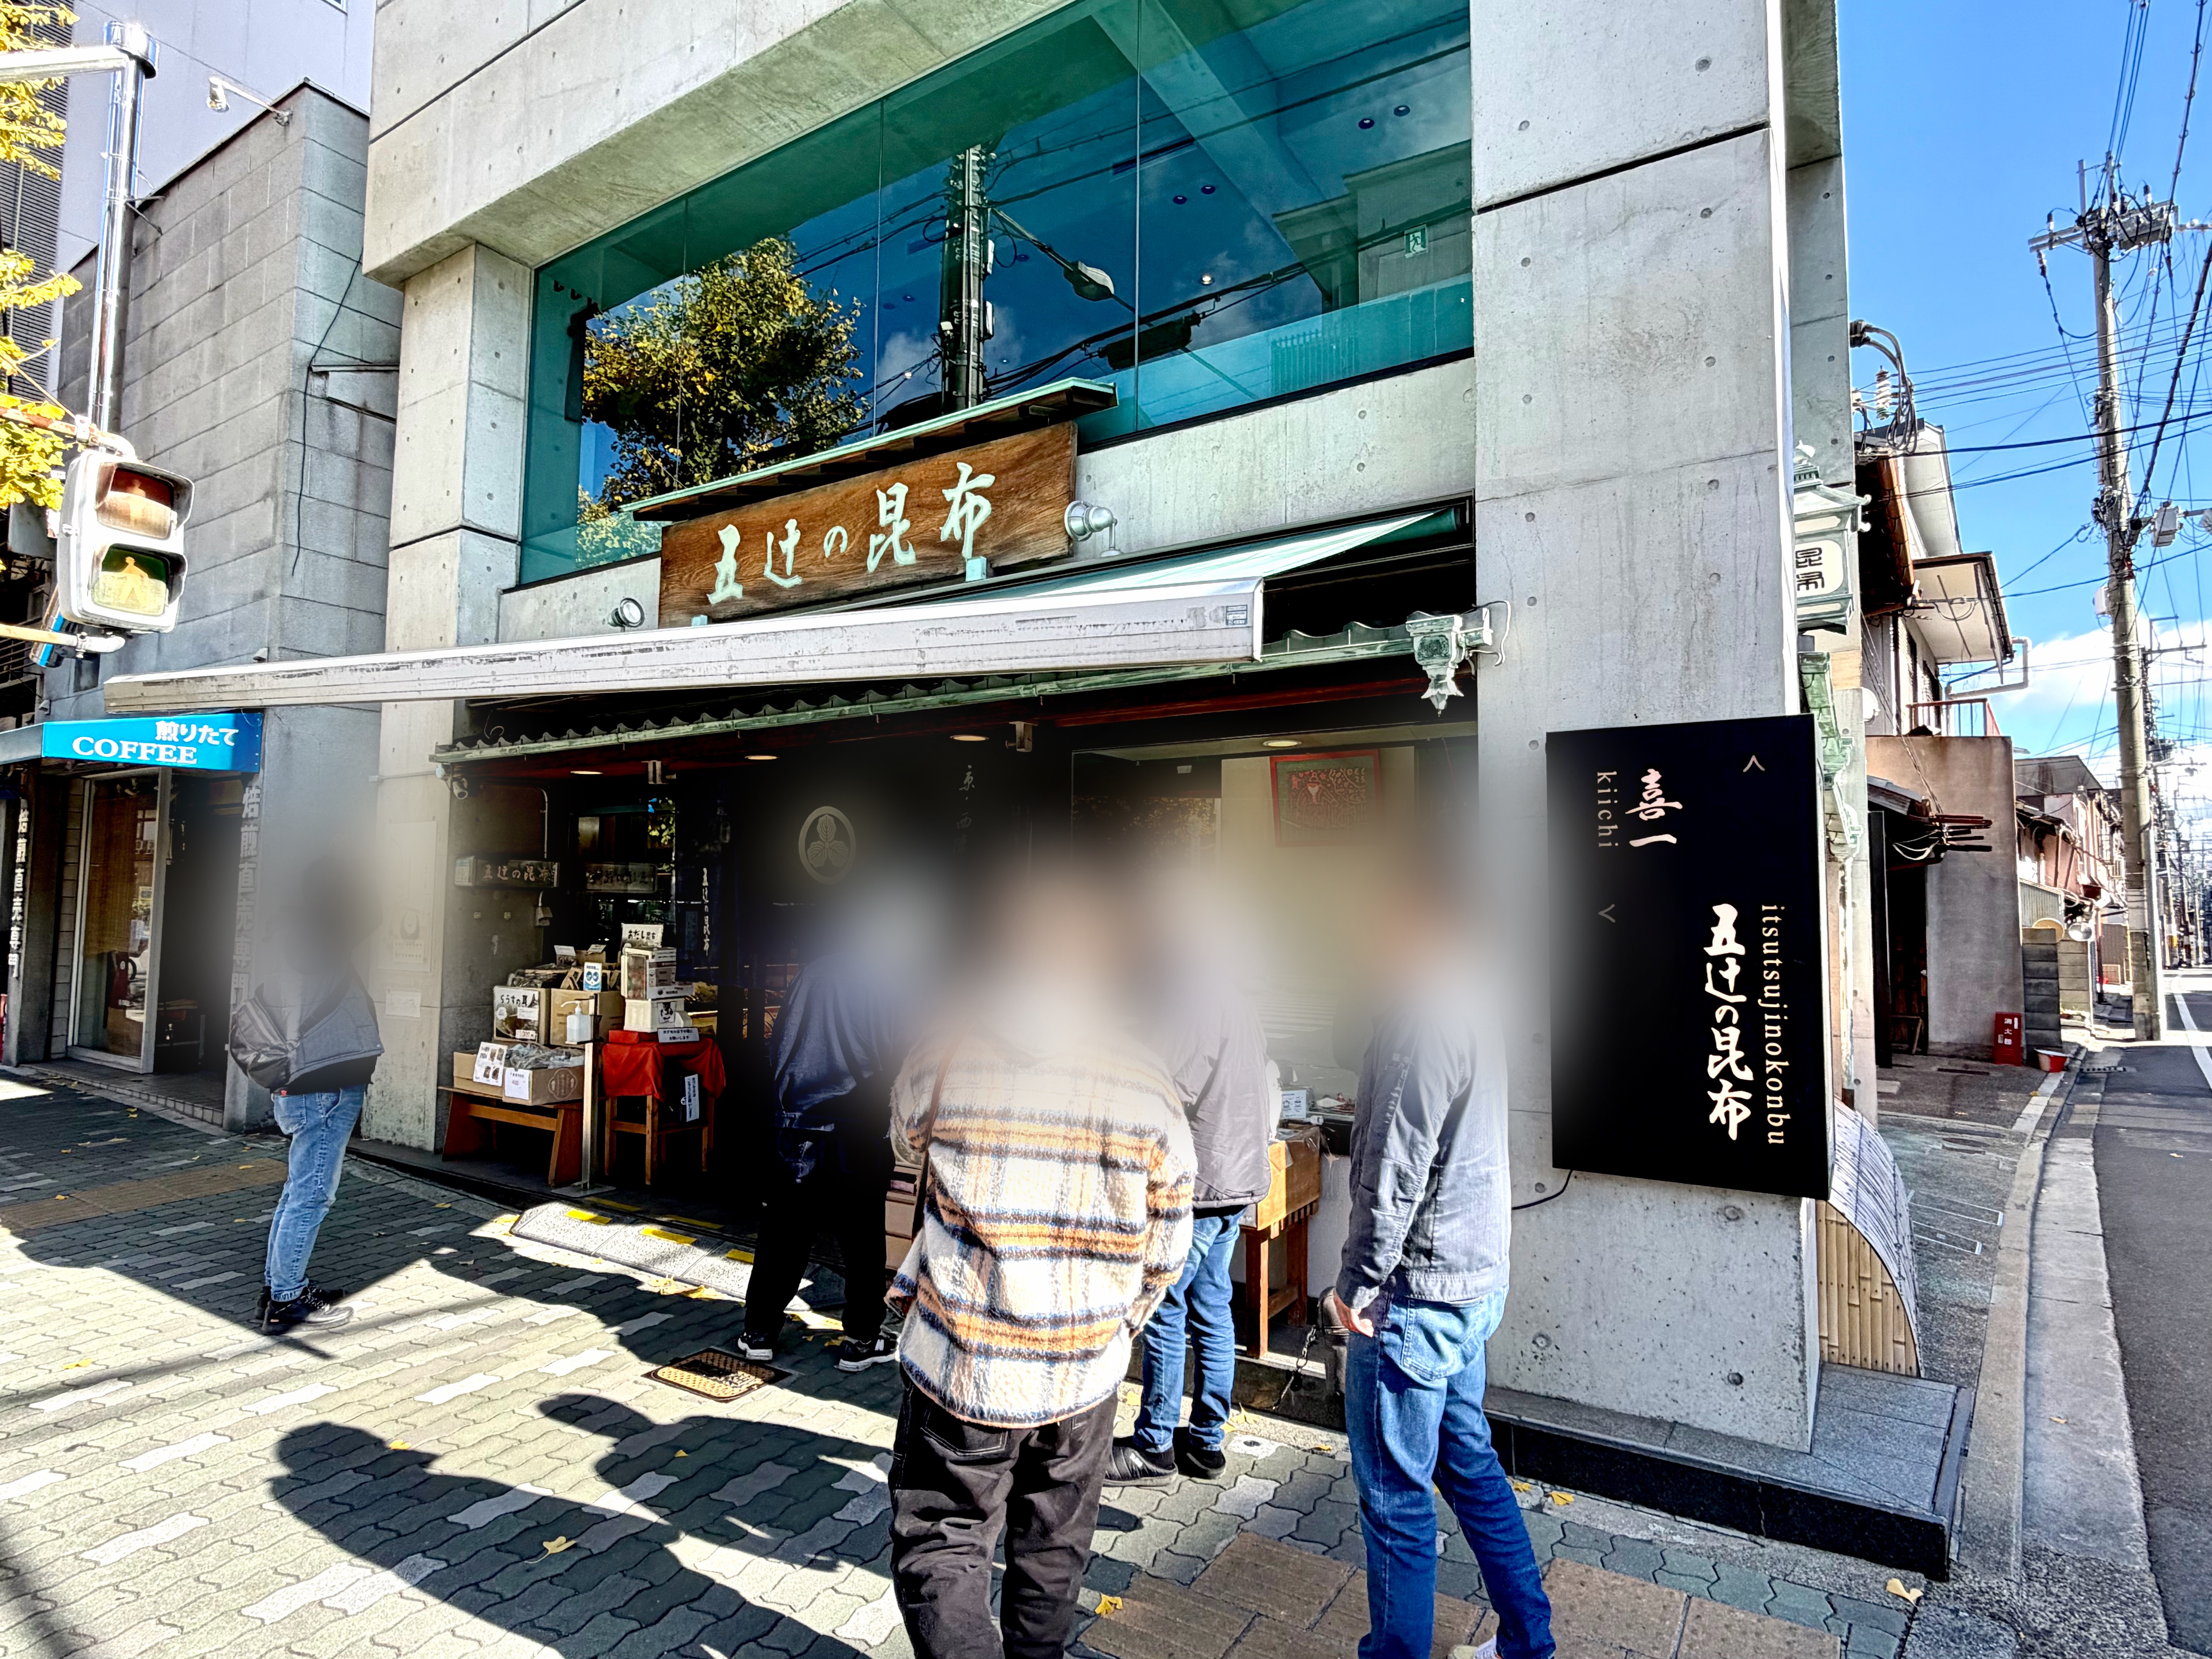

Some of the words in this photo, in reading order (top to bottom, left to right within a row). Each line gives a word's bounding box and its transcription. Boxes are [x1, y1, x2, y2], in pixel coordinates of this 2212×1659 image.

[706, 462, 996, 605] 五辻の昆布
[73, 737, 198, 765] COFFEE
[155, 720, 239, 747] 煎りたて
[1596, 771, 1620, 849] kiichi
[1625, 768, 1683, 847] 喜一
[1703, 903, 1754, 1140] 五辻の昆布
[1759, 904, 1790, 1145] itsutsujinokonbu
